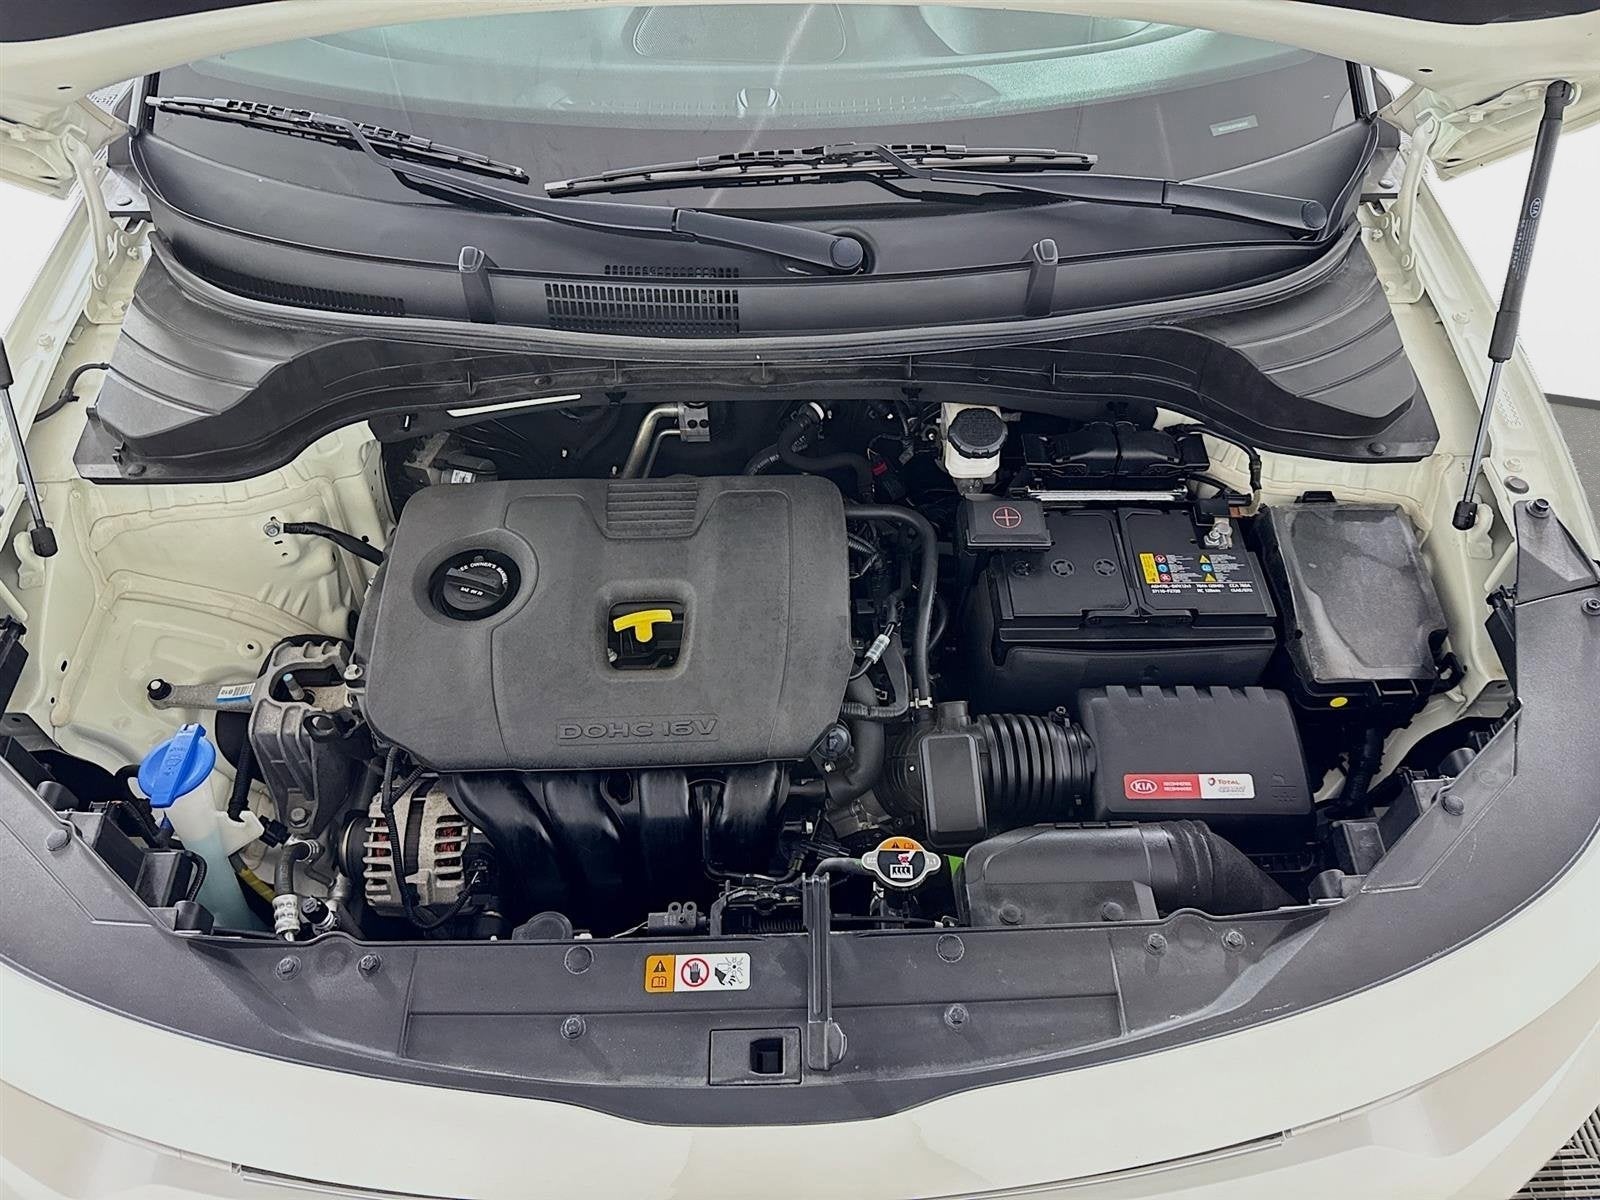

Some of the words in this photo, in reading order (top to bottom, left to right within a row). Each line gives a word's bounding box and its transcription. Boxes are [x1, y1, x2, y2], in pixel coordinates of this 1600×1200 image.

[559, 722, 654, 740] DOHC
[663, 718, 718, 737] 16V
[1135, 782, 1153, 791] KIA
